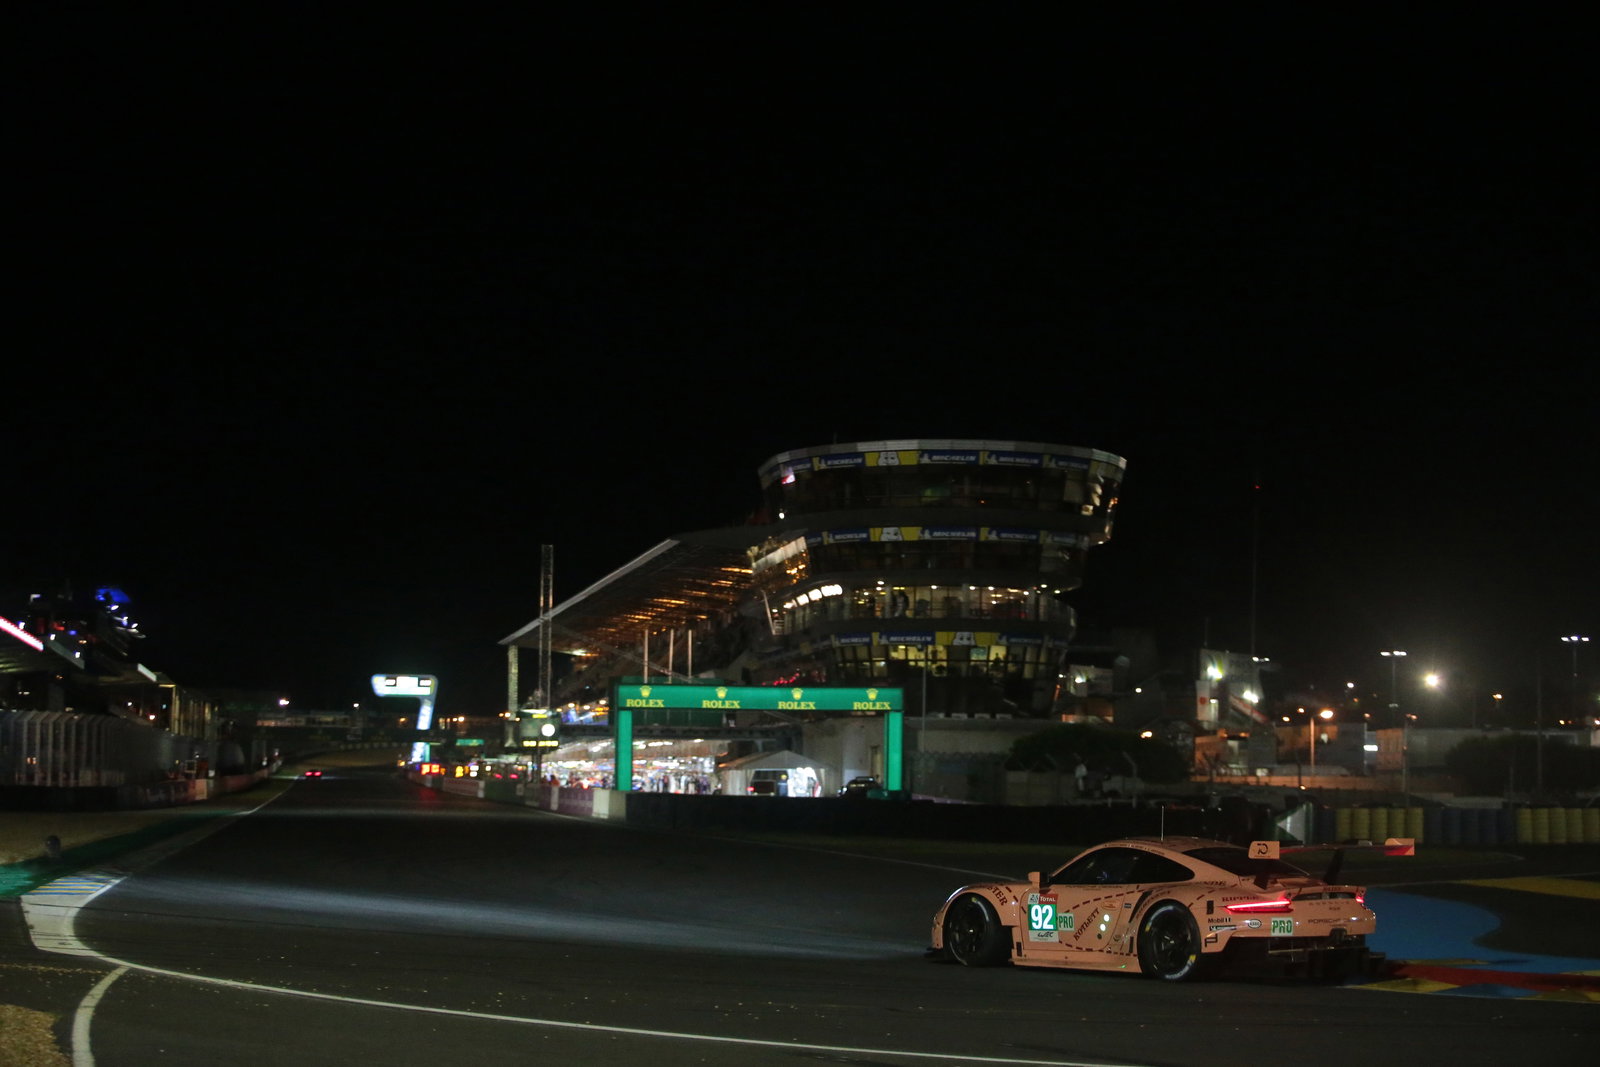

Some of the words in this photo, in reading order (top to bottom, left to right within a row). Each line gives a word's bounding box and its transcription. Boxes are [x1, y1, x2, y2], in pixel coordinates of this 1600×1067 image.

[931, 454, 977, 463] MICHELIN
[626, 698, 665, 708] ROLEX
[702, 699, 741, 709] ROLEX
[777, 701, 816, 710] ROLEX
[853, 701, 892, 711] ROLEX
[1031, 904, 1054, 930] 92
[1058, 915, 1074, 929] PRO
[1271, 919, 1292, 934] PRO
